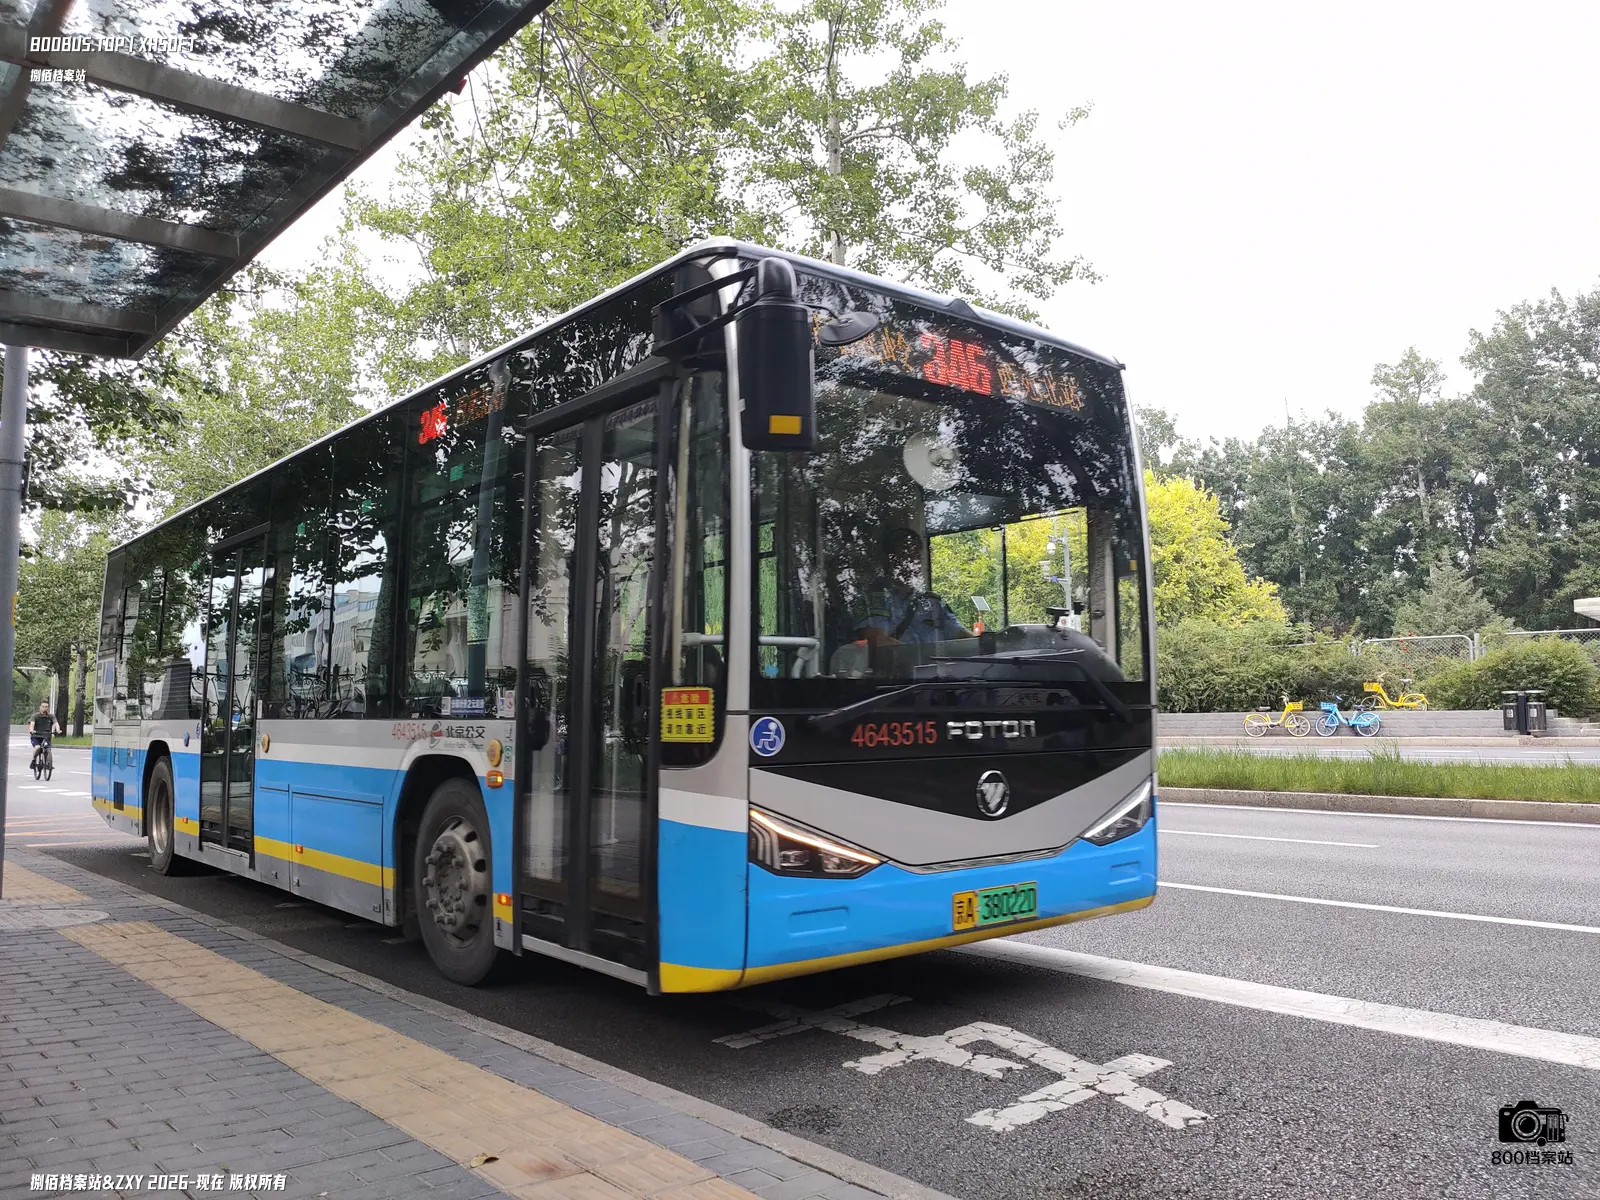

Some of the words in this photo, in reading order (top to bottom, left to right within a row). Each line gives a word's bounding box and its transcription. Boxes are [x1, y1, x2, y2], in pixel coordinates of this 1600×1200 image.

[391, 723, 428, 742] 4643515
[445, 725, 486, 739] 北京公交
[851, 720, 938, 747] 4643515
[946, 719, 1037, 740] FOTON
